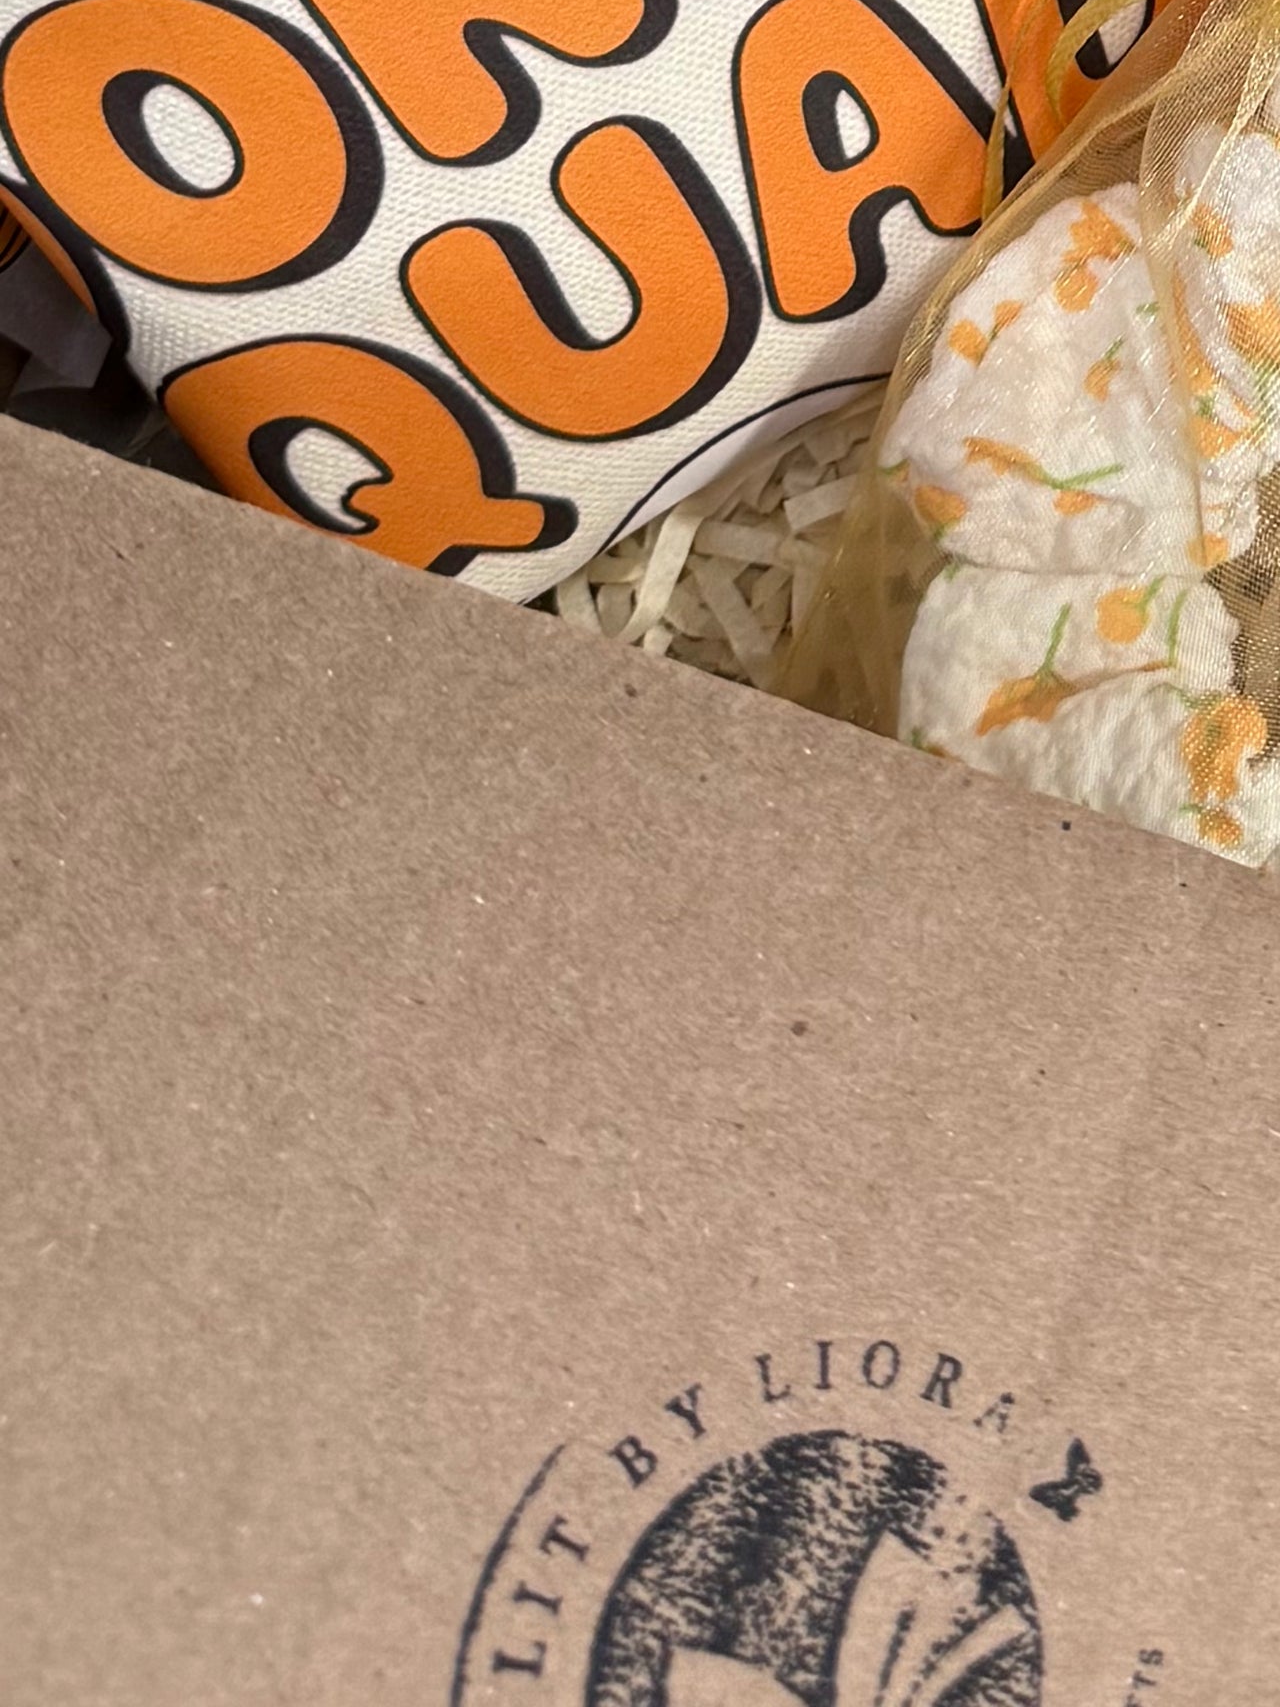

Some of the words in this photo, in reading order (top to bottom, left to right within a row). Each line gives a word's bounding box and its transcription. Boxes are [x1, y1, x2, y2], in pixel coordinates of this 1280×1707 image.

[492, 1513, 597, 1682] LIT
[608, 1382, 709, 1489] BY
[753, 1338, 1018, 1434] LIORA
